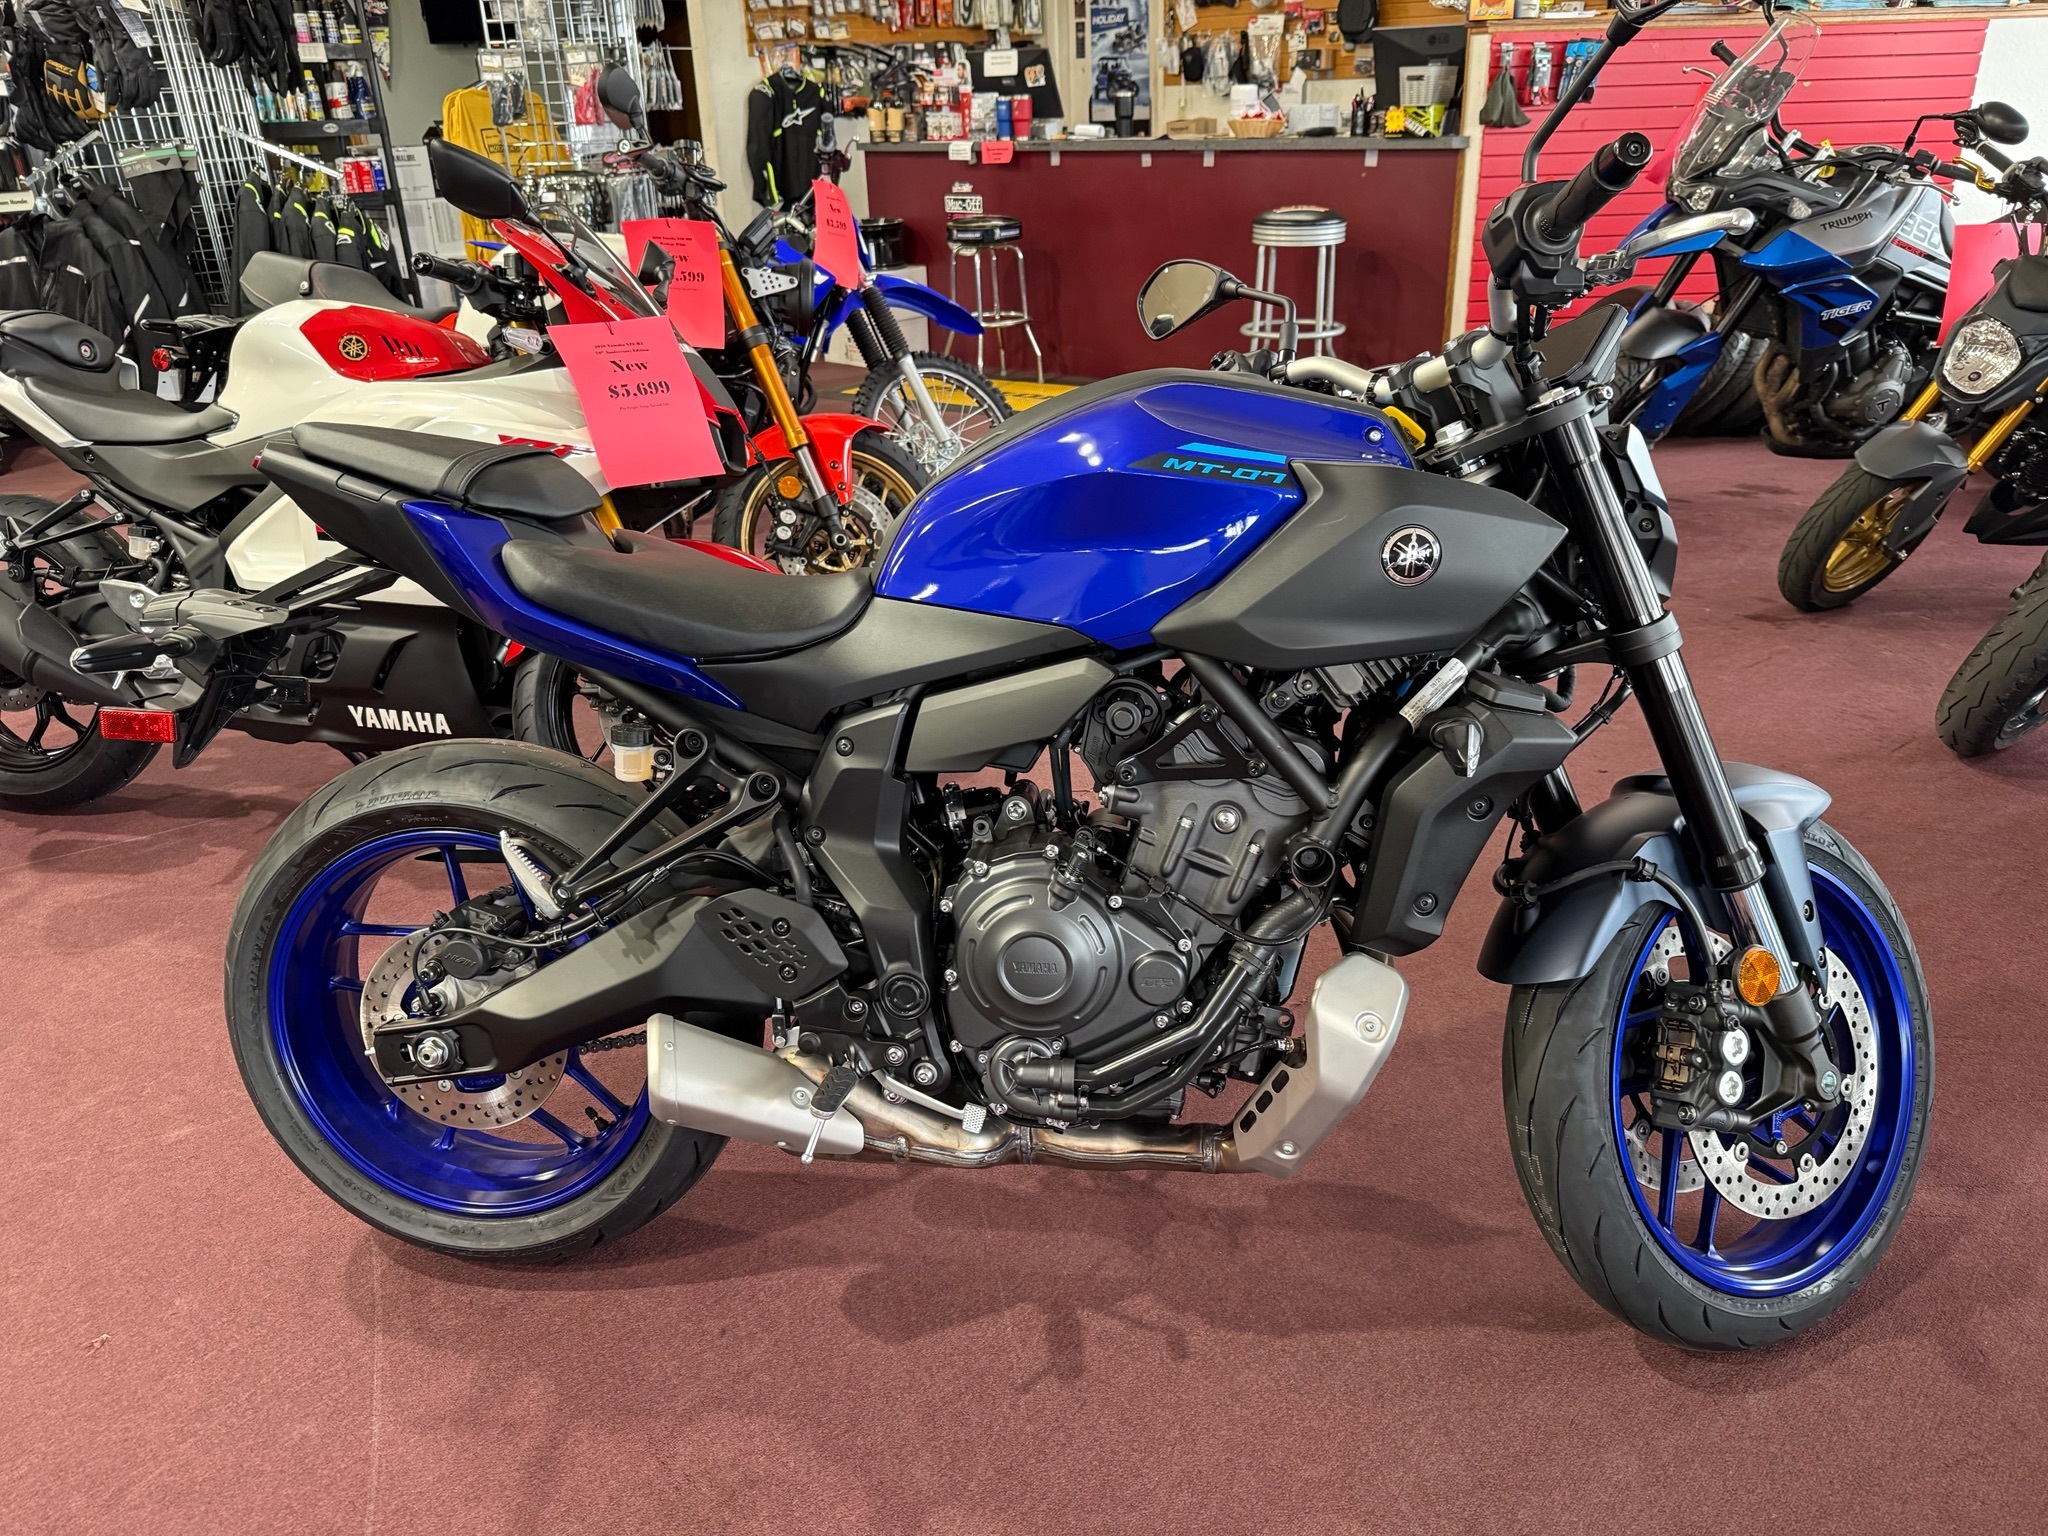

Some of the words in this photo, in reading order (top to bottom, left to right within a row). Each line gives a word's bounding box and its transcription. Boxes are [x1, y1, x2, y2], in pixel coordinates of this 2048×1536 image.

[1092, 13, 1126, 25] HOLIDAY
[1438, 34, 1449, 44] LG
[947, 199, 981, 211] Muc-Off
[1820, 211, 1873, 231] TRIUMPH
[1891, 237, 1927, 258] SPORT
[1821, 300, 1873, 320] TIGER
[609, 359, 648, 373] New
[608, 380, 671, 400] $5,699
[1163, 458, 1287, 484] MT-07
[347, 705, 452, 735] YAMAHA
[367, 789, 441, 807] DUNLOP
[1803, 831, 1836, 849] NLOP
[1012, 960, 1058, 975] YAMAHA
